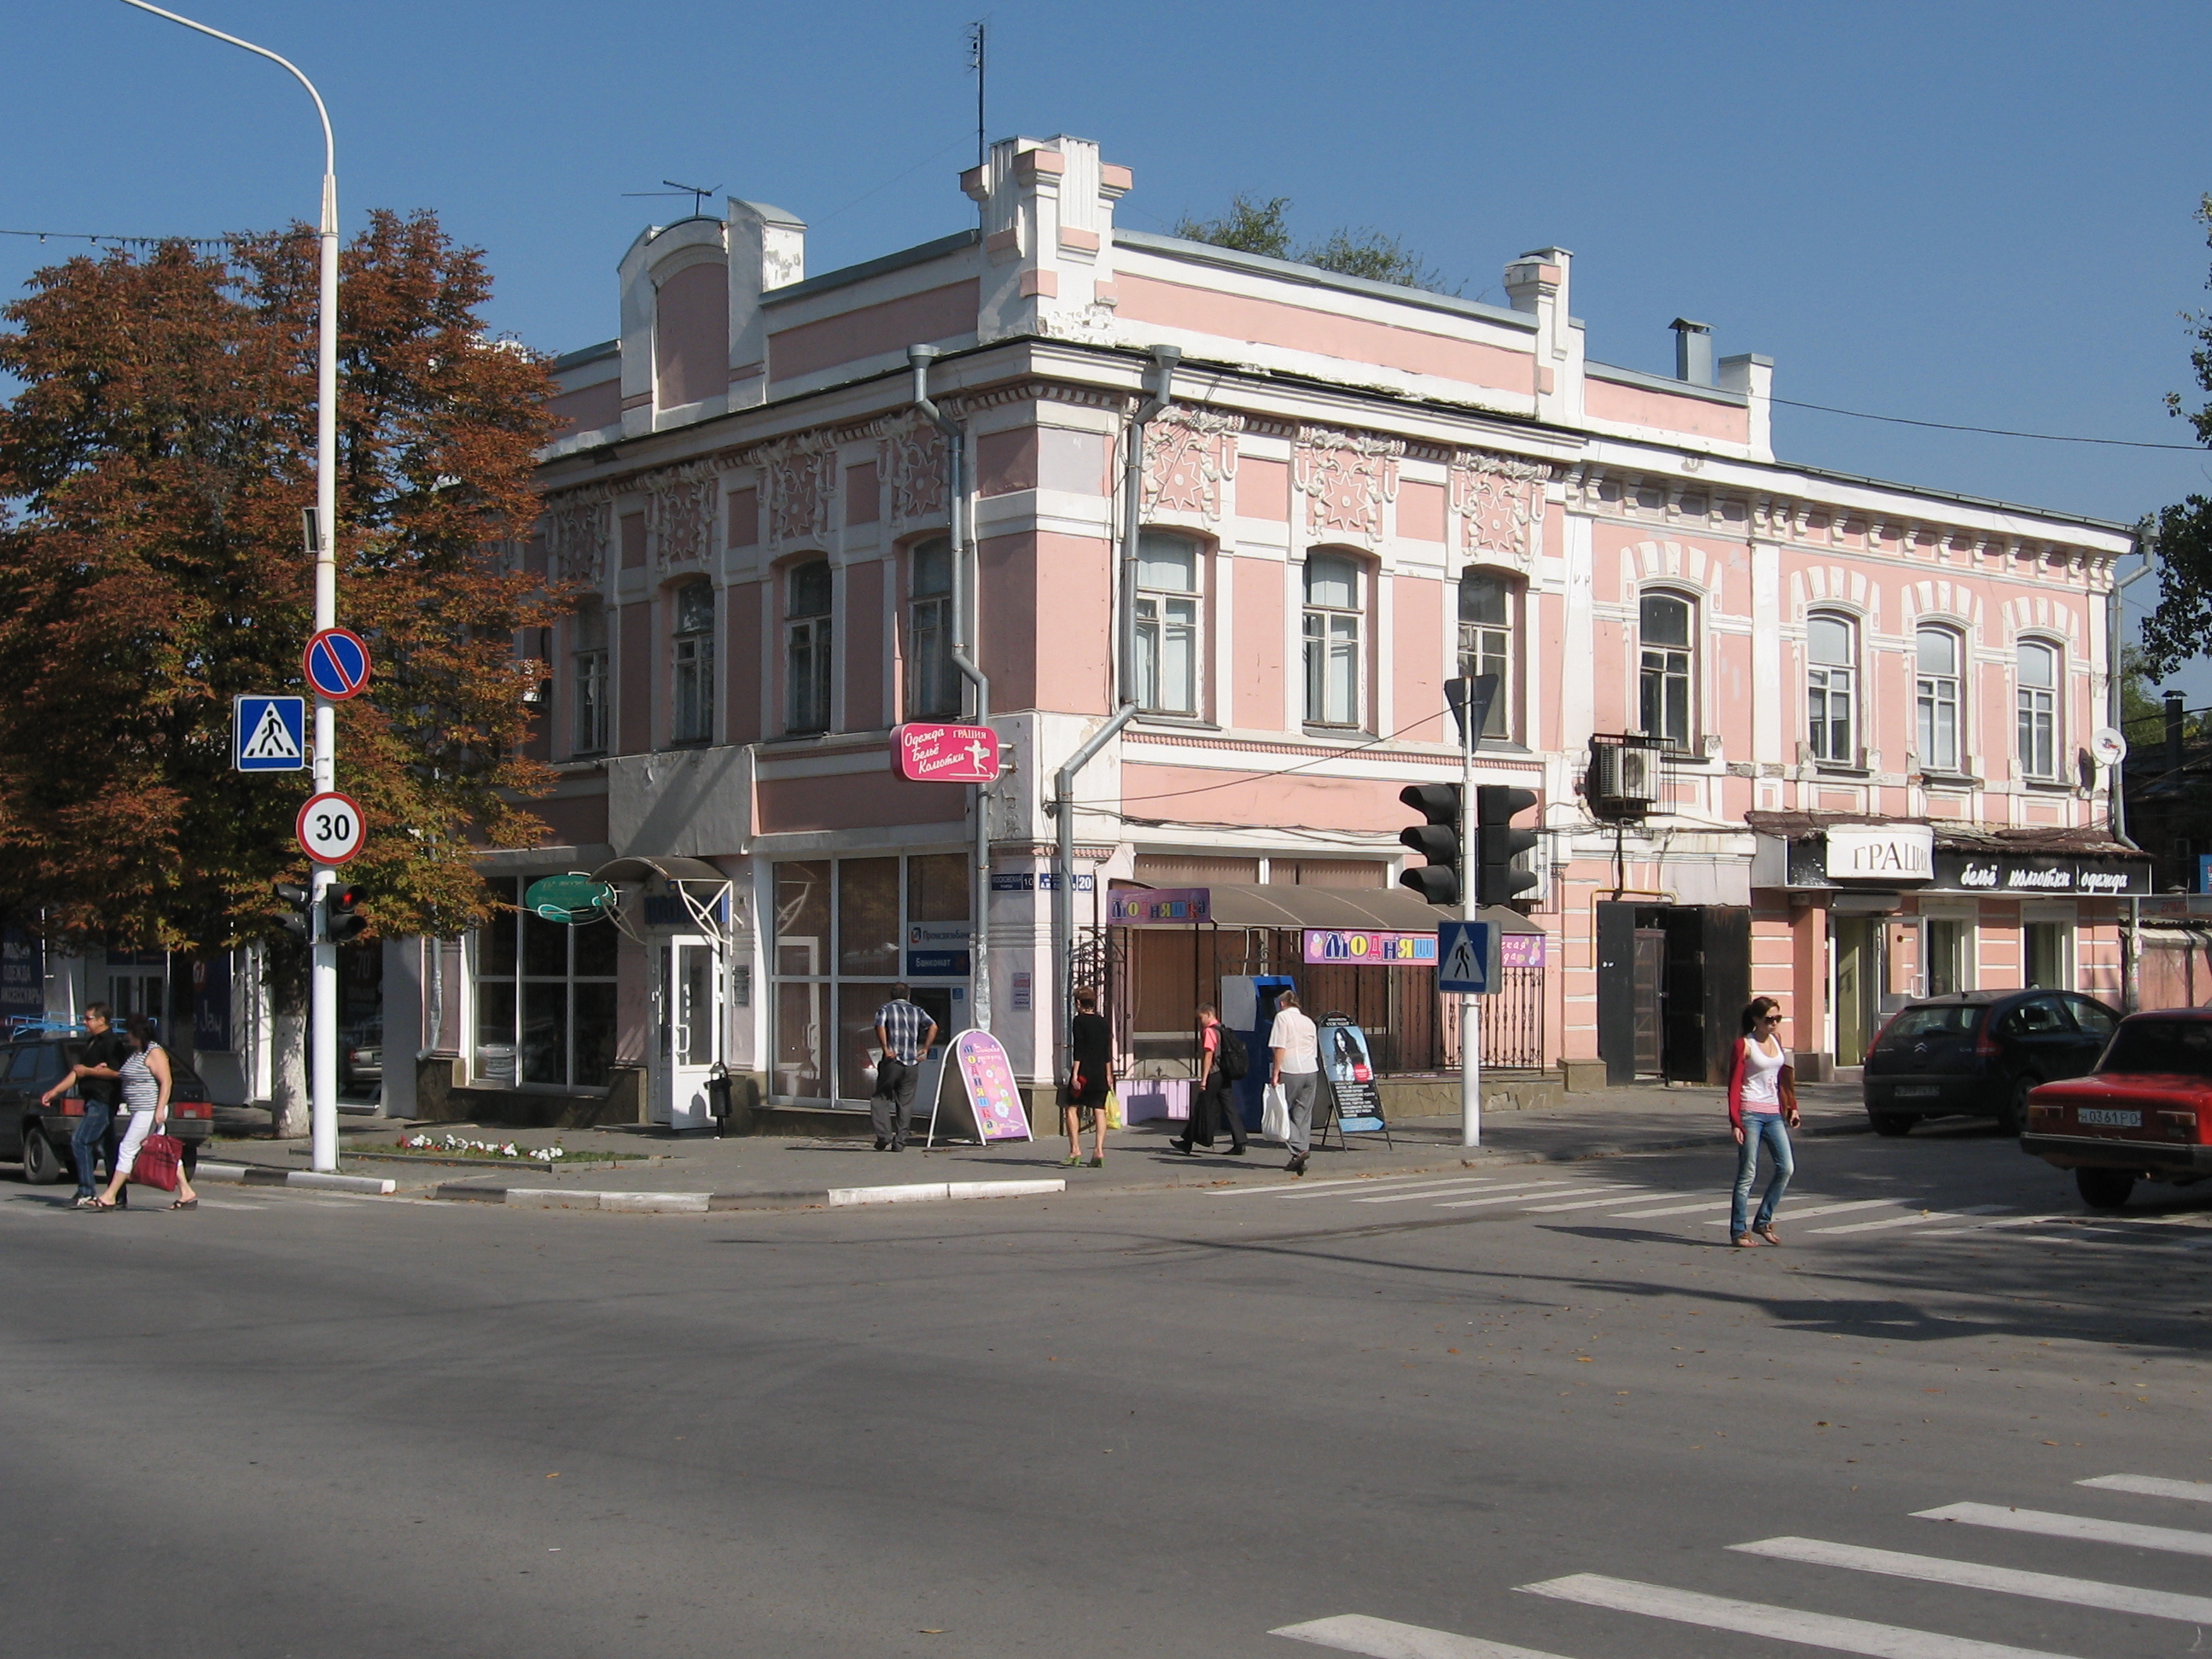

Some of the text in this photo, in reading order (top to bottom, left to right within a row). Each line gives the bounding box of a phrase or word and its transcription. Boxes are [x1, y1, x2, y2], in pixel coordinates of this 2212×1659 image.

[905, 728, 946, 748] Одежда
[952, 729, 987, 740] ГРАЦИЯ
[911, 743, 940, 762] Бельё
[917, 753, 966, 775] Колготки
[315, 813, 351, 841] 30
[1079, 876, 1092, 890] 20
[1960, 862, 2128, 894] бельё колготки одежда
[915, 958, 952, 968] Банкомат
